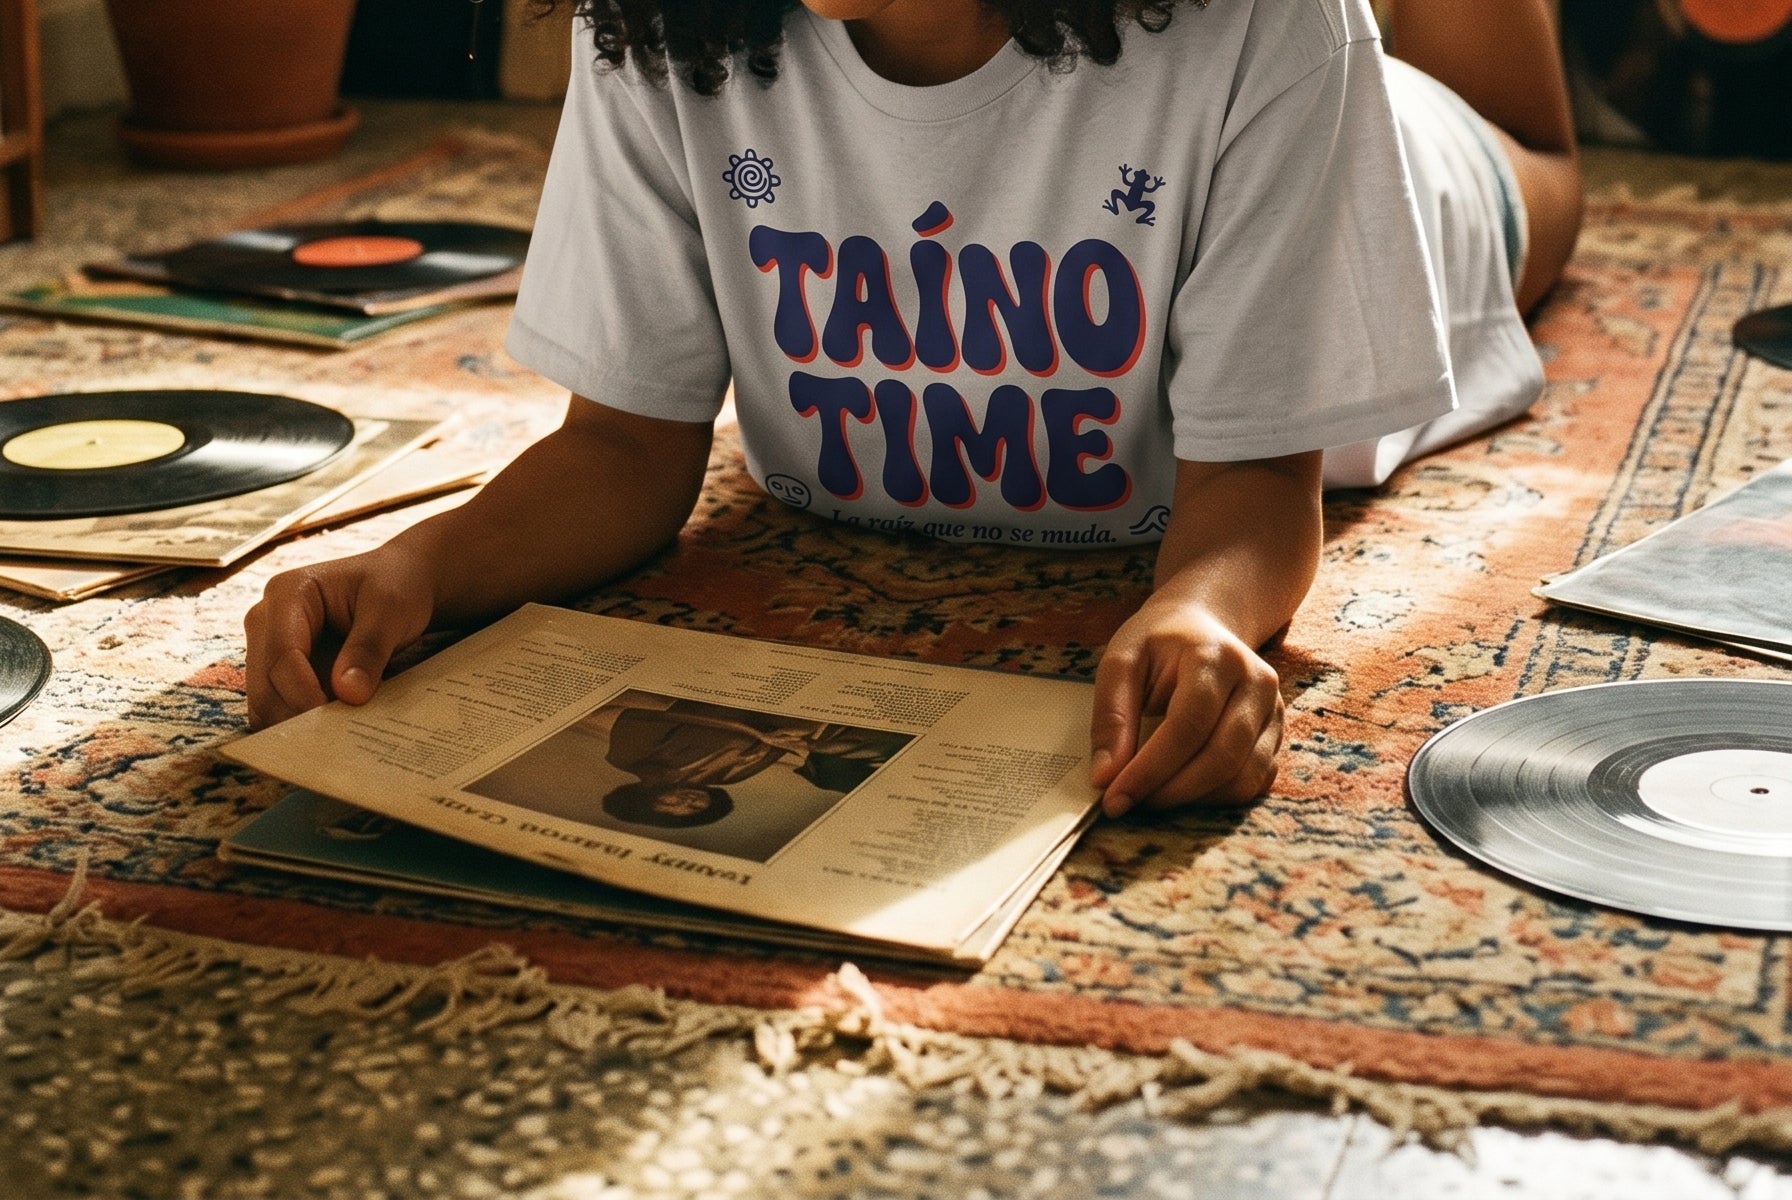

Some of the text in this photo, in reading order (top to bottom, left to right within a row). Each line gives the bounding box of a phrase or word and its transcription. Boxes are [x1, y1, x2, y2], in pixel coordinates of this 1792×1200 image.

[749, 200, 1146, 378] TAÍNO
[788, 371, 1132, 512] TIME
[923, 521, 965, 539] que
[972, 525, 1001, 541] no
[1010, 528, 1034, 543] se
[1041, 524, 1117, 544] muda.
